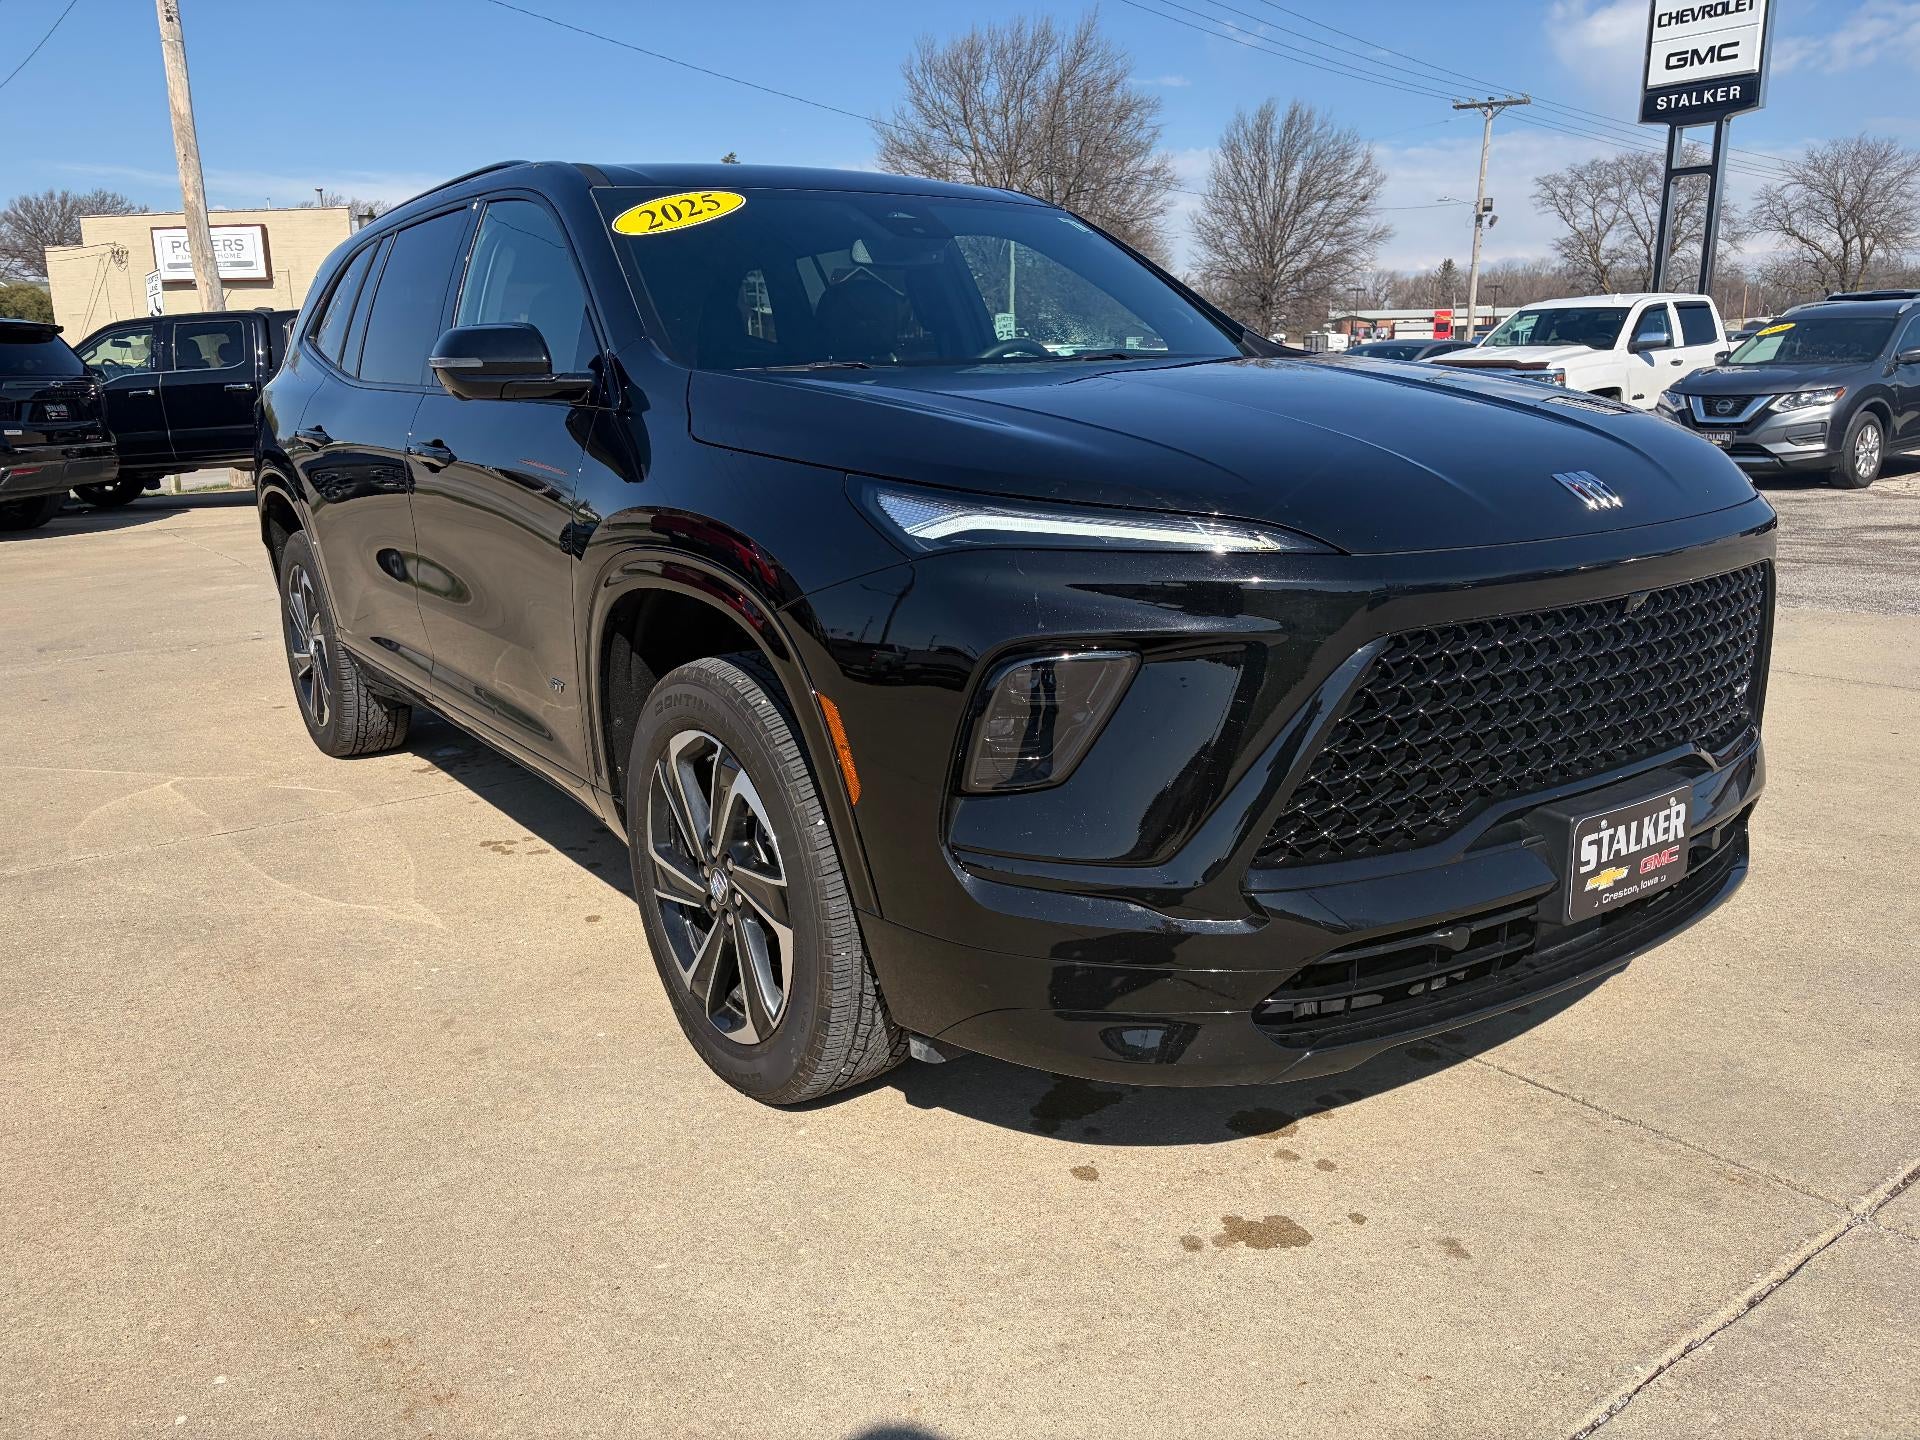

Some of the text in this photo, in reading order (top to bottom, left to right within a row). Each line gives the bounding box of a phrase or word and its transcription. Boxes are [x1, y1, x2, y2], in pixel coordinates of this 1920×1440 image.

[1665, 41, 1740, 70] GMC
[1656, 86, 1741, 110] STALKER
[639, 194, 721, 230] 2025
[171, 239, 245, 254] POERS
[997, 330, 1013, 339] 25
[1580, 803, 1686, 874] STALKER
[1640, 845, 1680, 874] GMC
[1602, 876, 1659, 904] Creston, Iowa
